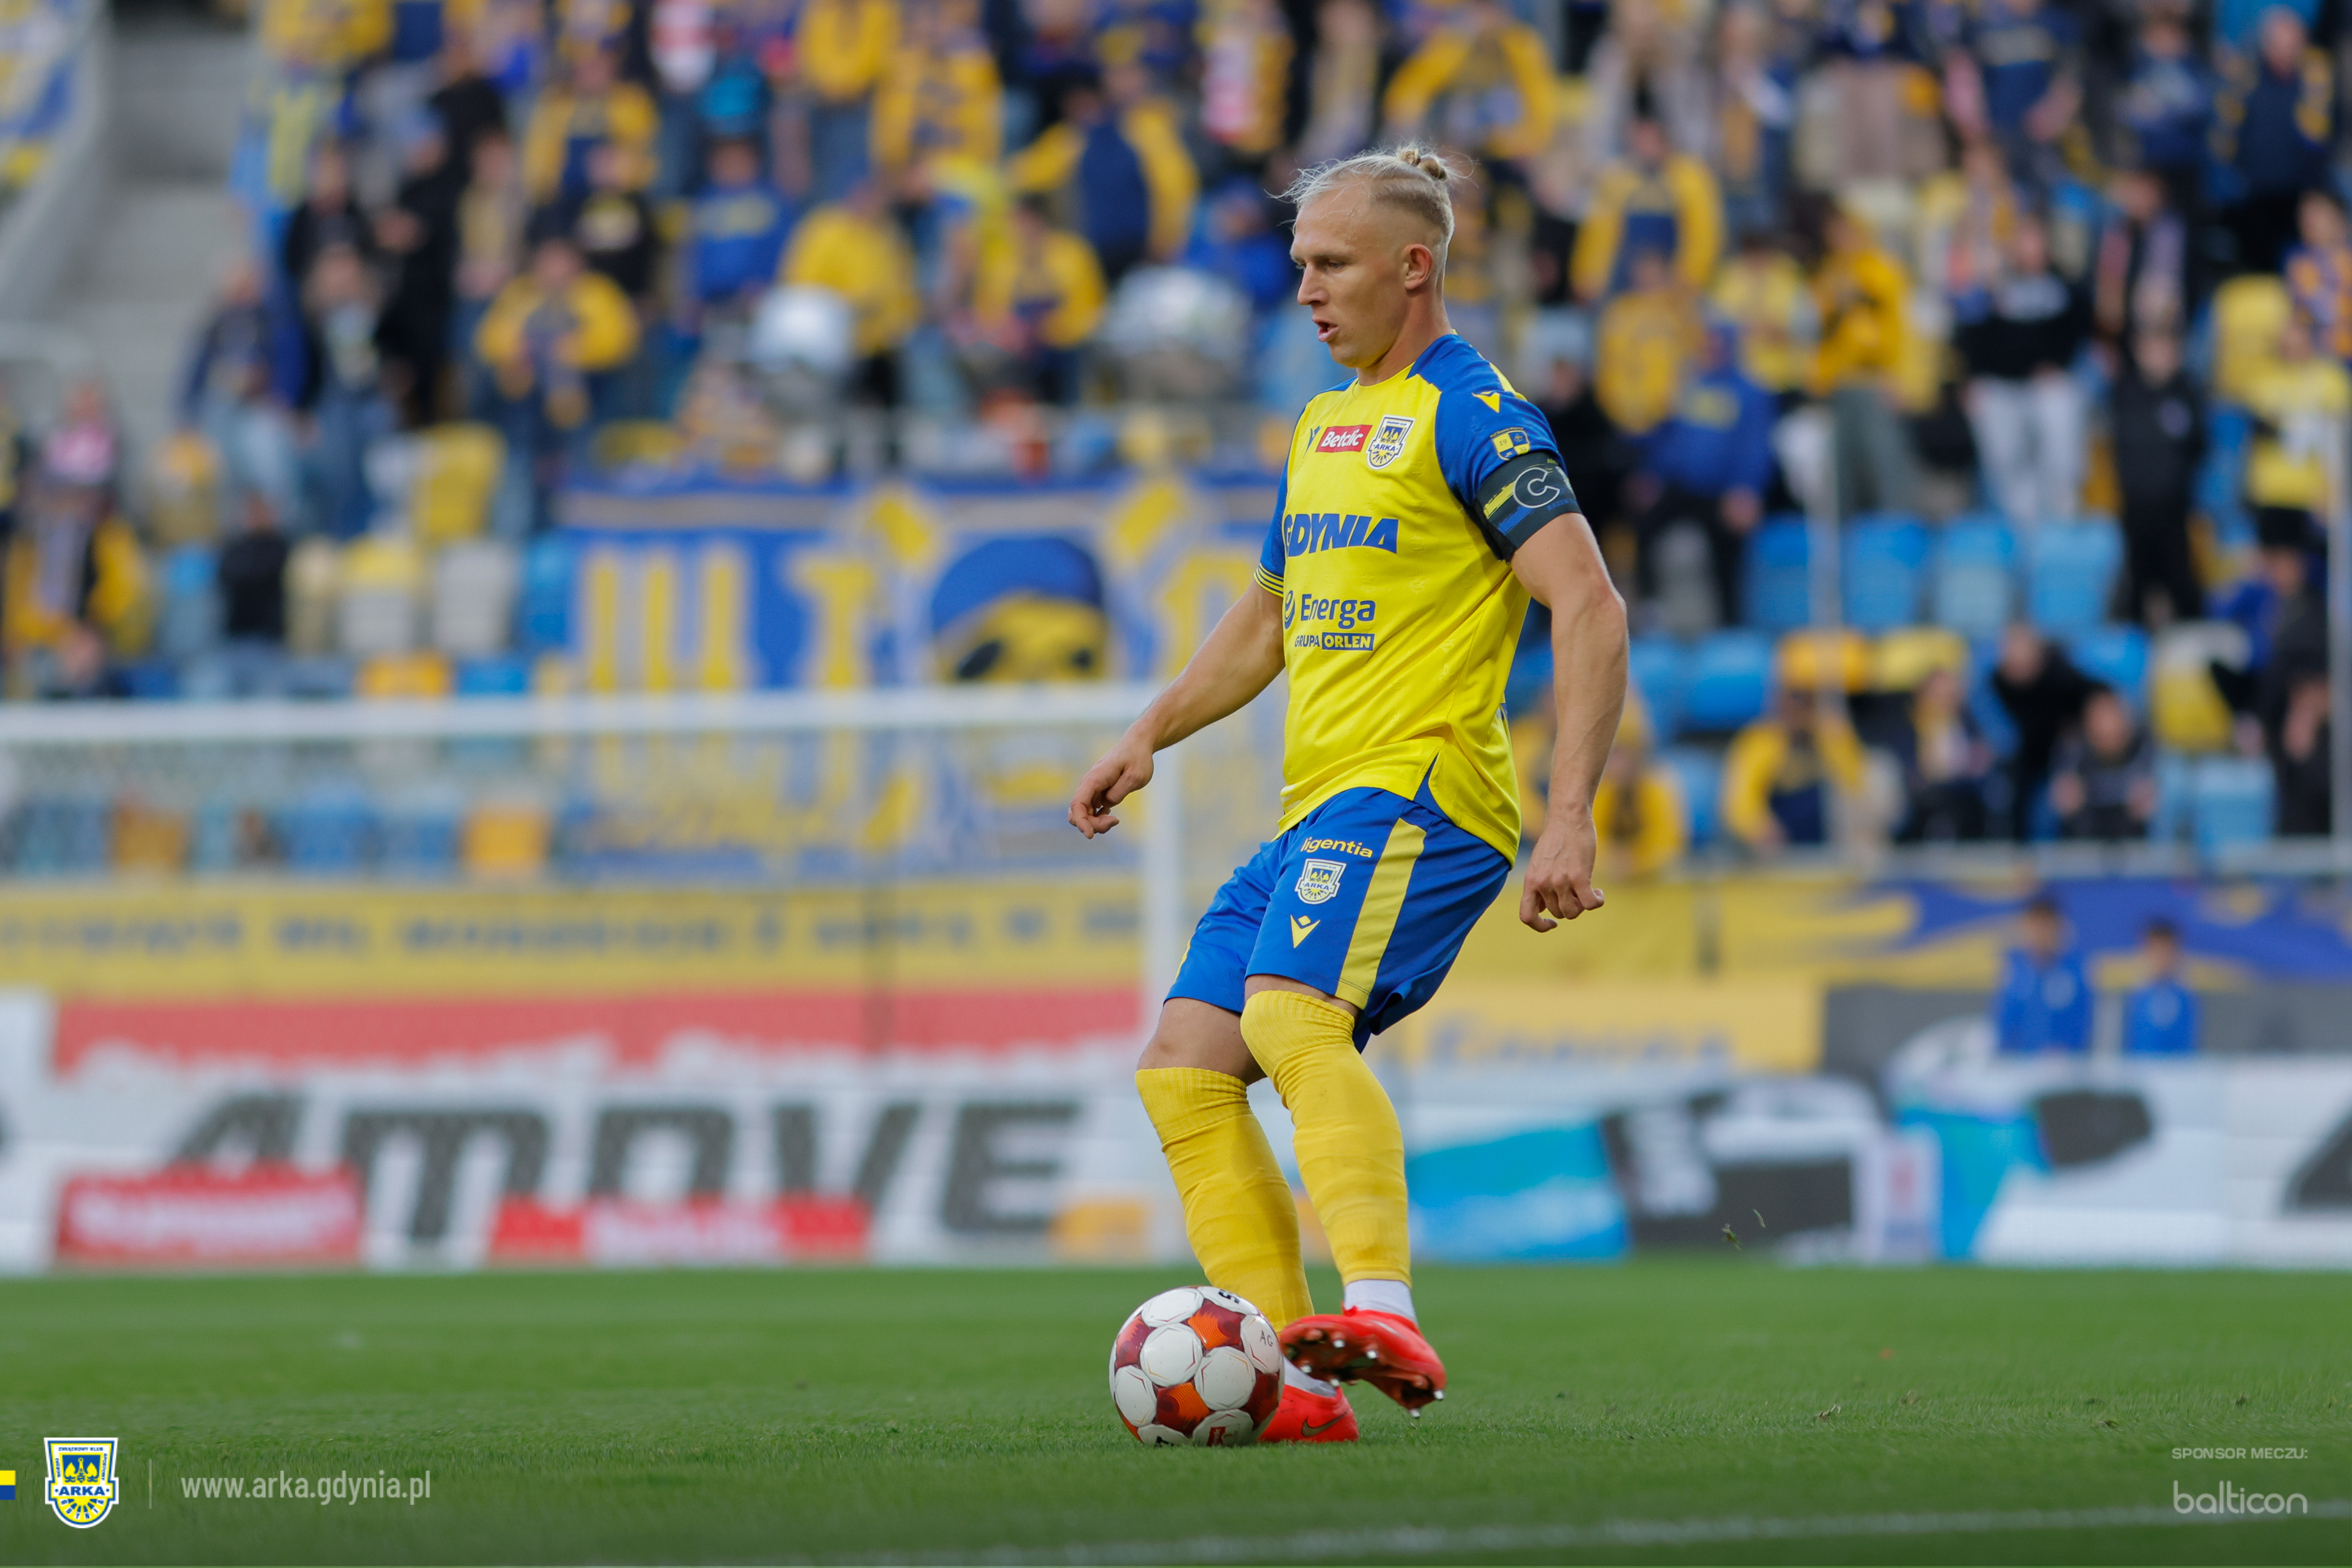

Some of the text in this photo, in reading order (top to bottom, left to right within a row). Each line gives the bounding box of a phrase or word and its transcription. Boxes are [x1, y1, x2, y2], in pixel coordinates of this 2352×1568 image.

[1321, 429, 1364, 448] Betclic
[1374, 443, 1396, 452] ARKA
[1512, 467, 1561, 508] C
[1284, 513, 1399, 558] GDYNIA
[1300, 593, 1376, 629] Energa
[1294, 635, 1372, 648] GRUPA ORLEN
[1300, 836, 1374, 858] ligentia
